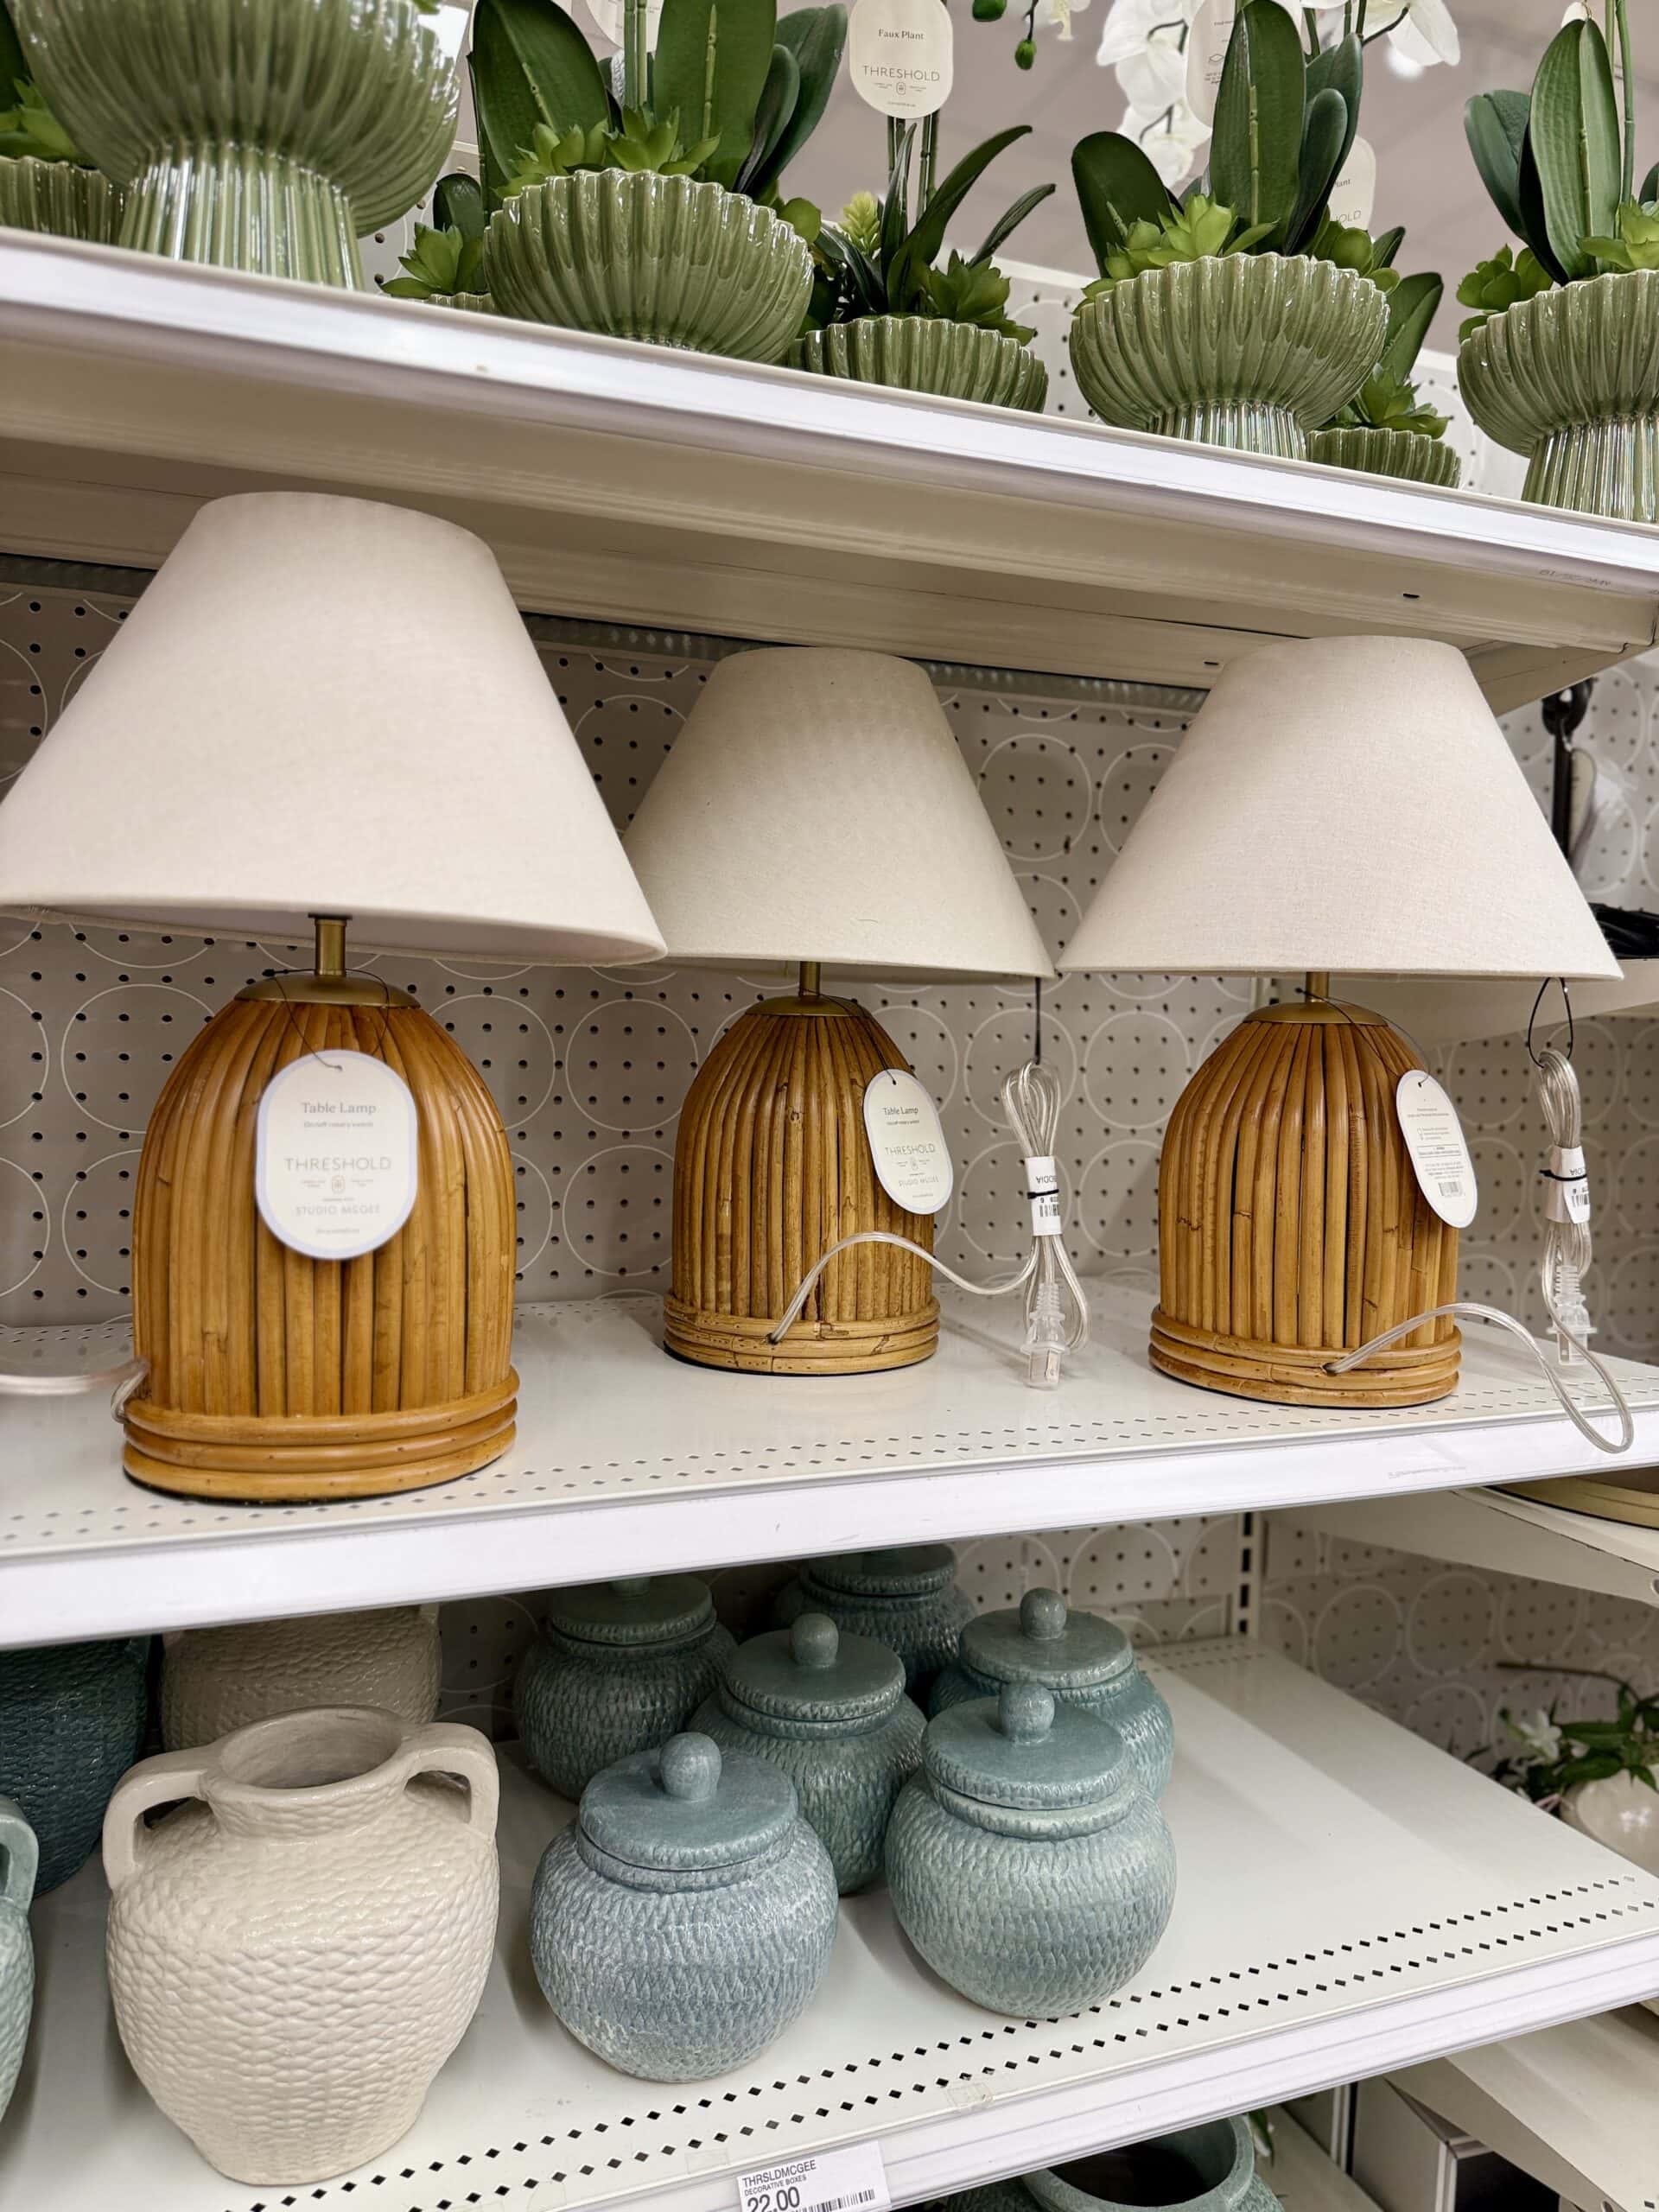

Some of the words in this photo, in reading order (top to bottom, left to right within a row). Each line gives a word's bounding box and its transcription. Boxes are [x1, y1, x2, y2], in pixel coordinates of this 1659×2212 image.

[878, 29, 899, 39] Faux
[901, 30, 925, 40] Plant
[862, 65, 940, 82] THRESHOLD
[302, 1102, 336, 1114] Table
[340, 1102, 377, 1116] Lamp
[882, 1108, 900, 1116] Table
[900, 1106, 919, 1116] Lamp
[885, 1143, 936, 1155] THRESHOLD
[283, 1157, 392, 1172] THRESHOLD
[295, 1205, 338, 1216] STUDIO
[742, 2159, 817, 2188] THRSLDMCGEE
[744, 2178, 784, 2196] DECORATIVE
[785, 2174, 807, 2186] BOXES
[747, 2186, 800, 2212] 22.00
